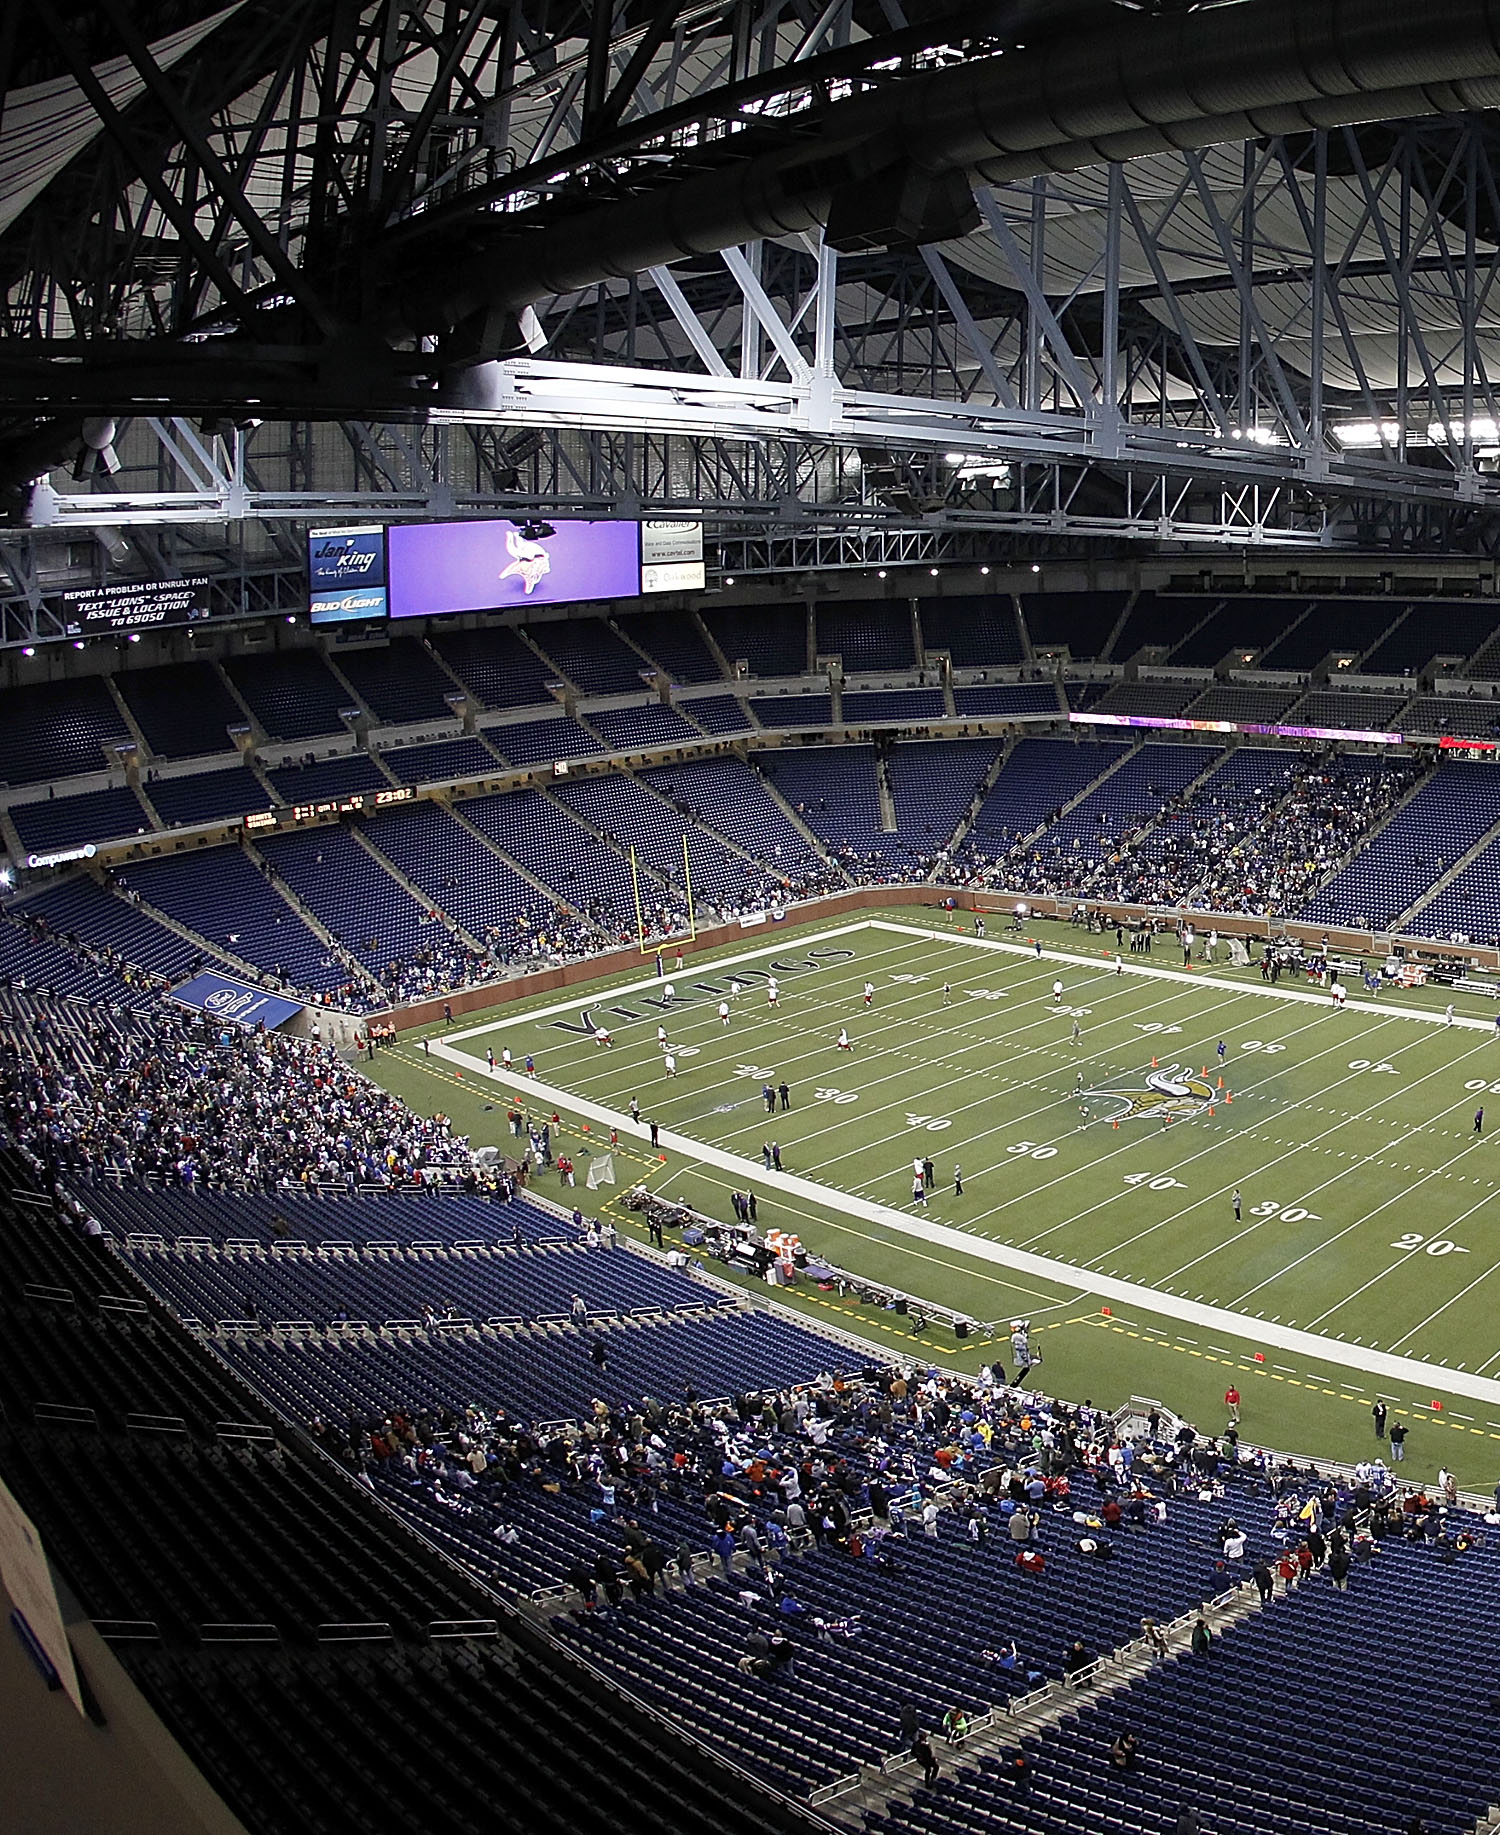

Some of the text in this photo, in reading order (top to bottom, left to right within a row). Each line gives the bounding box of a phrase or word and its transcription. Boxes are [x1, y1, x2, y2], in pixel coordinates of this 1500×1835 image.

[64, 589, 96, 600] REPORT
[98, 588, 104, 596] A
[106, 584, 144, 596] PROBLEM
[158, 579, 190, 590] UNRULY
[192, 578, 208, 586] FAN
[77, 601, 105, 612] TEXT
[152, 591, 196, 602] <SPACE>
[86, 600, 190, 620] ISSUE & LOCATION
[310, 602, 340, 612] BUD
[126, 612, 165, 624] 69050
[1240, 1040, 1287, 1054] 50
[732, 1064, 776, 1080] 20
[814, 1087, 859, 1105] 30
[905, 1113, 952, 1131] 40
[1006, 1140, 1058, 1160] 50
[1122, 1171, 1177, 1190] 40
[1249, 1200, 1309, 1223] 30
[1389, 1232, 1456, 1256] 20
